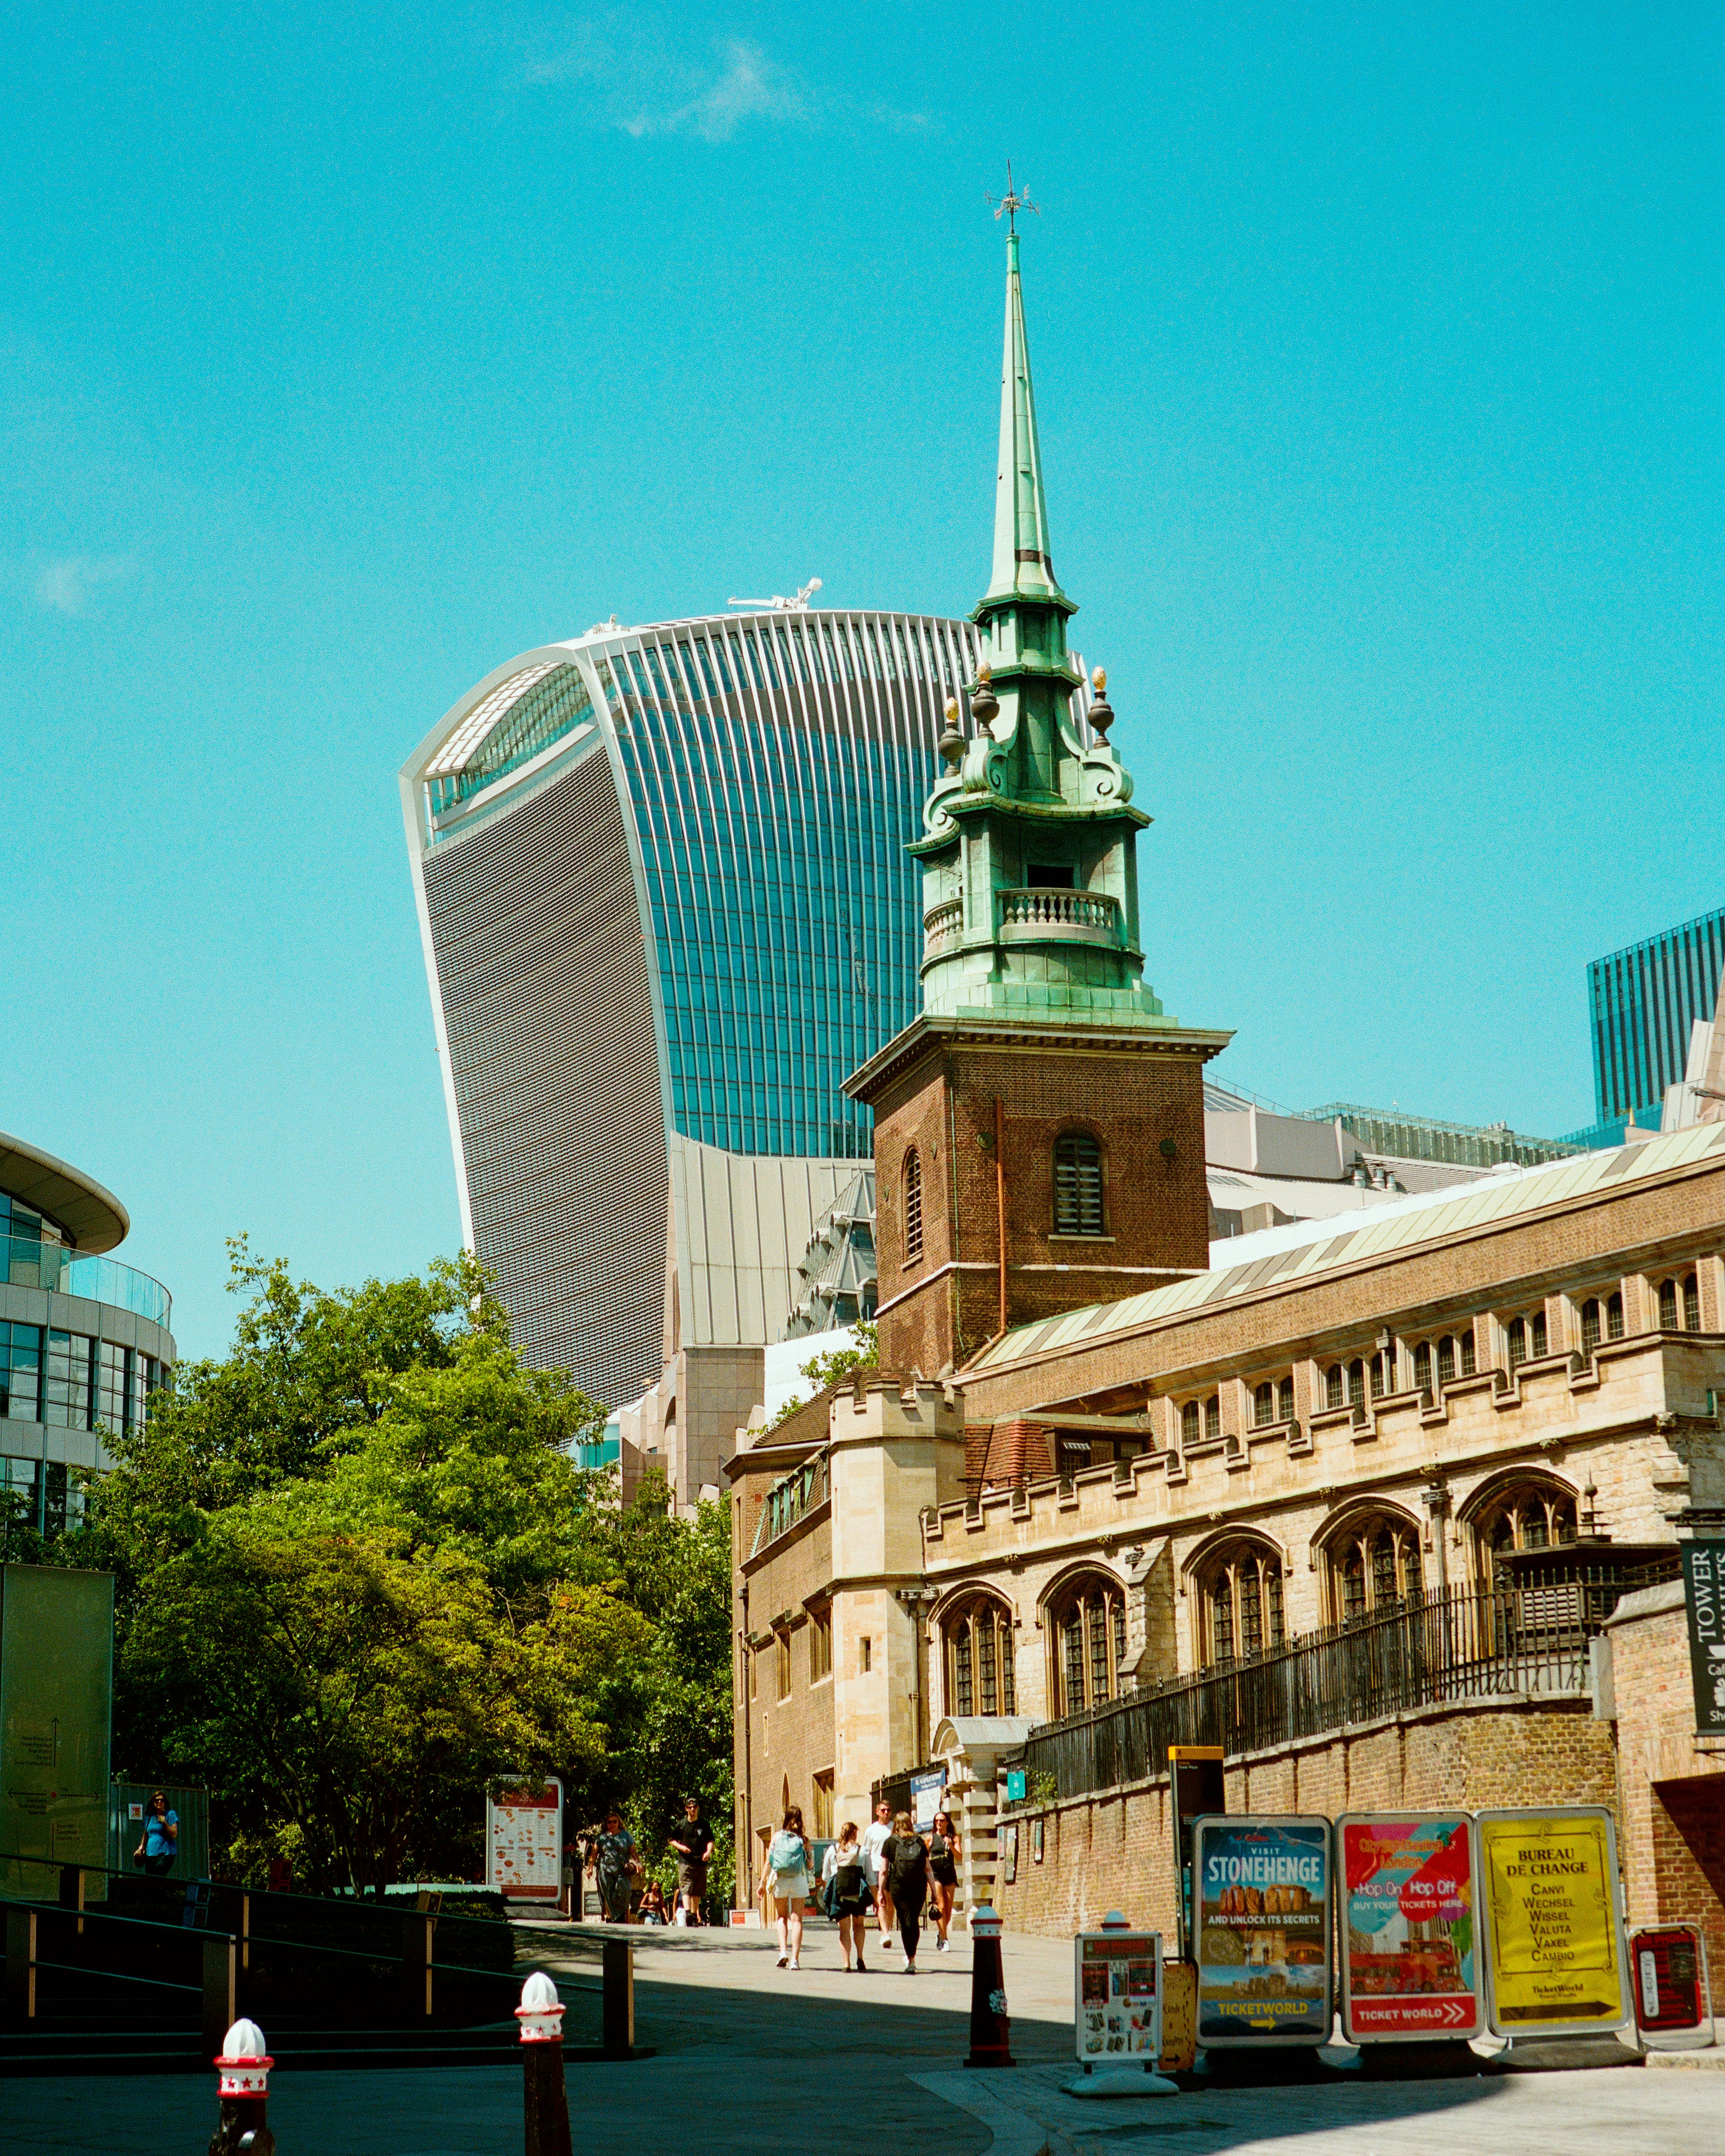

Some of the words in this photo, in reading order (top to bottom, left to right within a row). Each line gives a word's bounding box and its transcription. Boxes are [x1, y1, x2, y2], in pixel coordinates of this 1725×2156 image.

[1692, 1549, 1717, 1643] TOWER
[1380, 1854, 1424, 1869] London
[1518, 1848, 1575, 1861] BUREAU
[1208, 1857, 1319, 1881] STONEHENGE
[1507, 1865, 1526, 1877] DE
[1530, 1862, 1589, 1875] CHANGE
[1358, 1882, 1383, 1898] Hop
[1386, 1881, 1402, 1896] On
[1410, 1880, 1434, 1896] Hop
[1437, 1879, 1456, 1895] Off
[1353, 1901, 1372, 1910] BUY
[1400, 1900, 1437, 1909] TICKETS
[1439, 1899, 1463, 1908] HERE
[1208, 1915, 1228, 1925] AND
[1230, 1915, 1266, 1925] UNLOCK
[1268, 1915, 1281, 1924] ITS
[1283, 1915, 1319, 1924] SECRETS
[1218, 2002, 1309, 2015] TICKETWORLD
[1359, 2010, 1399, 2021] TICKET
[1402, 2008, 1442, 2019] WORLD
